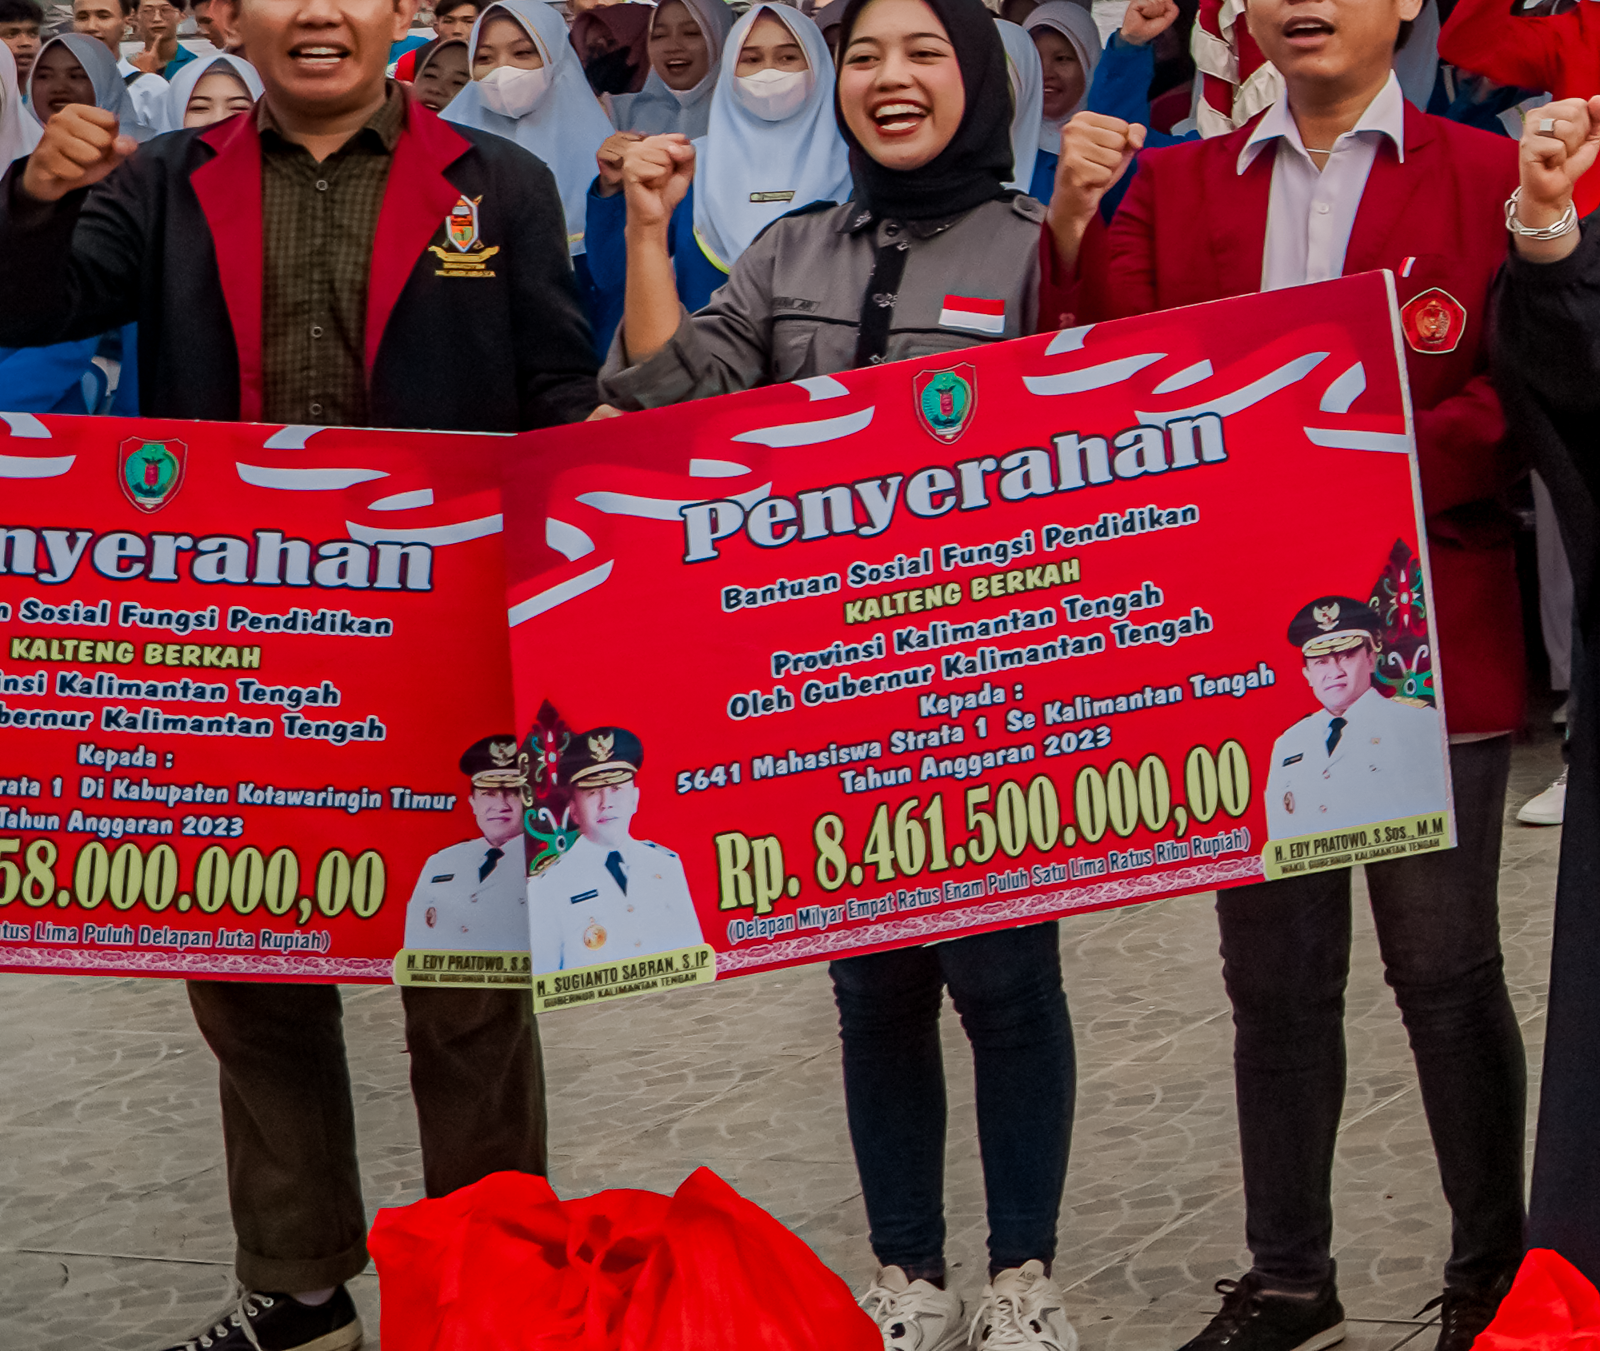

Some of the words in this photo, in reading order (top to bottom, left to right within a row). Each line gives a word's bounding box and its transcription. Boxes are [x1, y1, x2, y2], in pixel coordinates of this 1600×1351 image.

[680, 411, 1227, 564] Penyerahan
[721, 573, 841, 612] Bantuan
[848, 549, 933, 588] Sosial
[941, 530, 1034, 570] Fungsi
[1042, 504, 1200, 552] Pendidikan
[843, 582, 962, 624] KALTENG
[970, 558, 1081, 601] BERKAH
[19, 598, 110, 625] Sosial
[119, 602, 219, 635] Fungsi
[228, 606, 392, 637] Pendidikan
[771, 632, 885, 678] Provinsi
[893, 607, 1056, 654] Kalimantan
[1063, 581, 1163, 622] Tengah
[10, 637, 135, 664] KALTENG
[144, 643, 261, 668] BERKAH
[727, 685, 795, 720] Oleh
[802, 664, 934, 707] Gubernur
[941, 633, 1105, 680] Kalimantan
[1111, 607, 1213, 647] Tengah
[56, 670, 227, 703] Kalimantan
[237, 678, 341, 710] Tengah
[919, 682, 1006, 718] Kepada
[102, 706, 273, 738] Kalimantan
[281, 714, 386, 745] Tengah
[677, 762, 741, 794] 5641
[752, 742, 881, 780] Mahasiswa
[890, 724, 964, 753] Strata
[975, 717, 987, 738] 1
[1006, 709, 1036, 732] Se
[1044, 686, 1182, 726] Kalimantan
[1190, 662, 1276, 698] Tengah
[78, 744, 156, 771] Kepada
[840, 766, 911, 794] Tahun
[920, 744, 1035, 780] Anggaran
[1044, 725, 1111, 756] 2023
[52, 777, 62, 798] 1
[80, 777, 104, 799] Di
[113, 778, 228, 807] Kabupaten
[237, 783, 382, 813] Kotawaringin
[390, 787, 456, 811] Timur
[0, 806, 60, 830] Tahun
[67, 810, 174, 839] Anggaran
[182, 816, 244, 837] 2023
[715, 831, 800, 914] Rp.
[813, 739, 1250, 891] 8.461.500.000,00
[1275, 845, 1287, 861] H.
[1290, 841, 1309, 858] EDY
[727, 914, 795, 945] (Delapan
[797, 905, 844, 930] Milyar
[847, 894, 895, 921] Empat
[898, 887, 940, 910] Ratus
[942, 878, 984, 903] Enam
[986, 870, 1030, 896] Puluh
[1032, 862, 1067, 886] Satu
[1070, 854, 1106, 878] Lima
[1109, 847, 1152, 873] Ratus
[1155, 839, 1188, 864] Ribu
[1192, 826, 1251, 860] Rupiah)
[35, 921, 78, 943] Lima
[83, 923, 134, 946] Puluh
[139, 925, 212, 949] Delapan
[217, 929, 256, 949] Juta
[259, 930, 331, 953] Rupiah)
[407, 955, 419, 968] H.
[423, 955, 445, 969] EDY
[537, 980, 551, 996] H.
[554, 969, 618, 993] SUGIANTO
[681, 950, 709, 970] S.IP
[598, 980, 658, 999] KALIMANTAN
[661, 972, 697, 989] TENGAH
